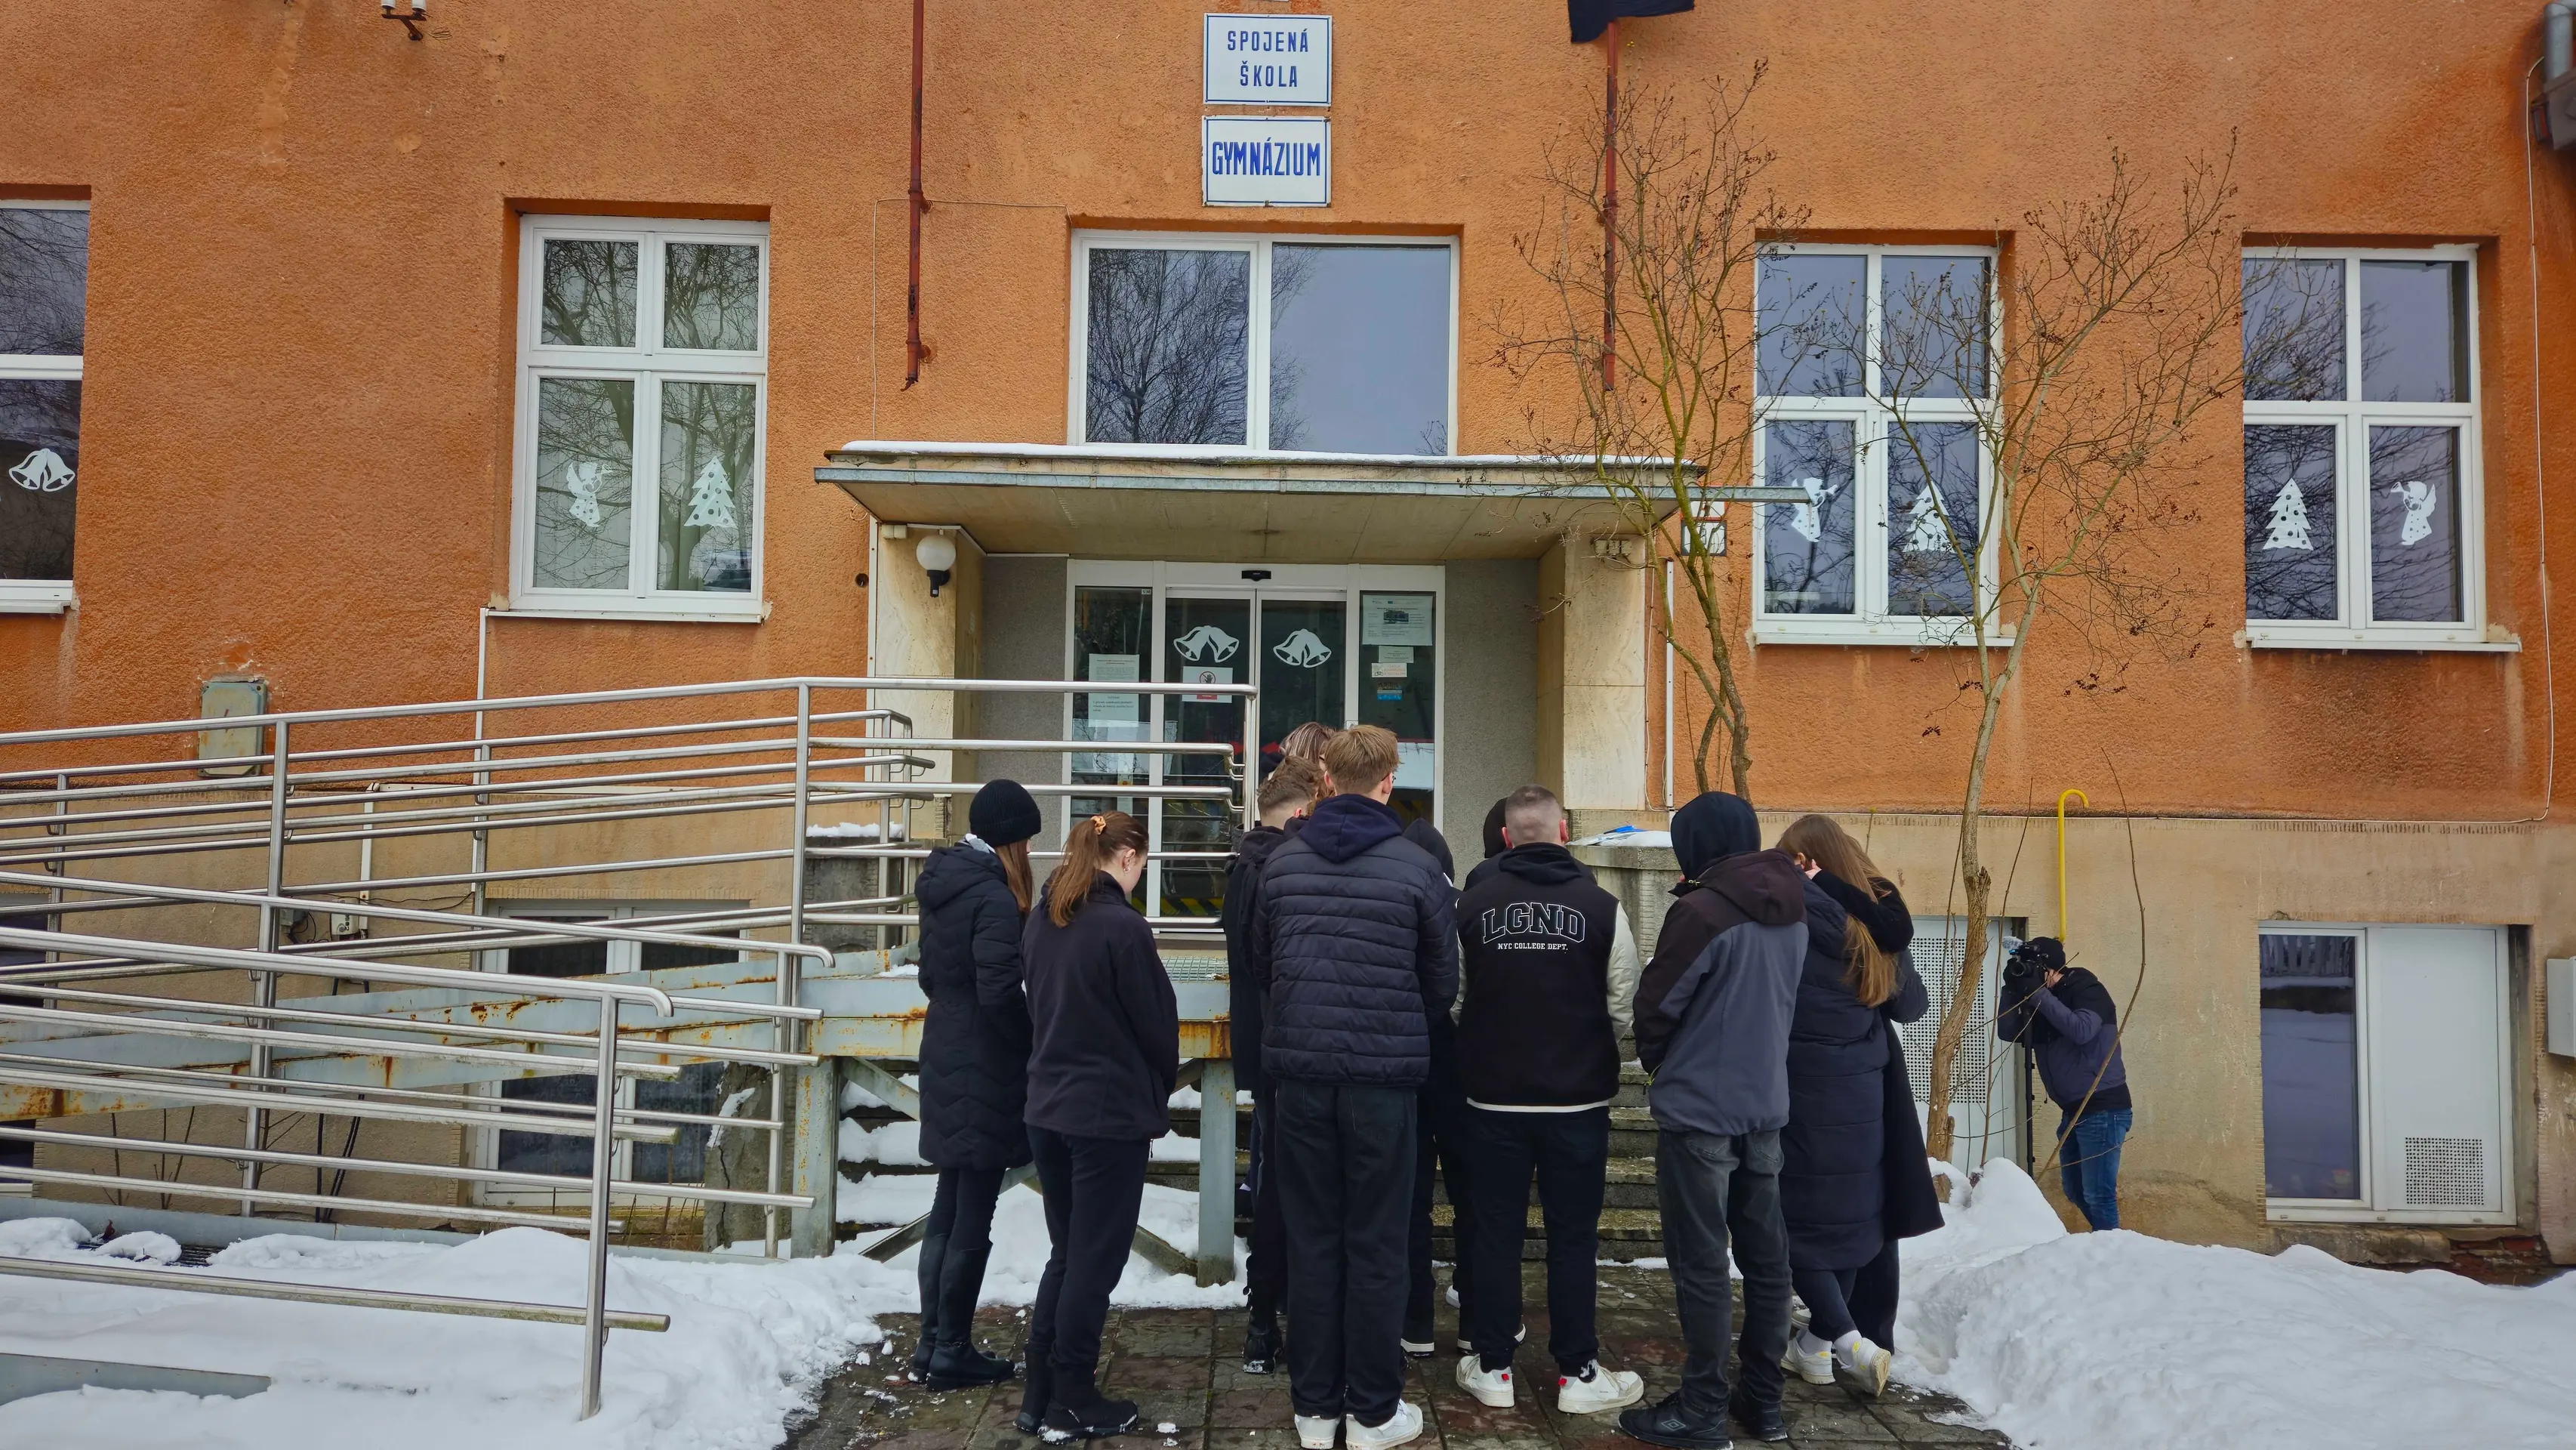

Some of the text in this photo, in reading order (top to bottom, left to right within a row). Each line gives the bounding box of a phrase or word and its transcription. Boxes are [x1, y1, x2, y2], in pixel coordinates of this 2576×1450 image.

[1227, 28, 1309, 53] SPOJENÁ
[1240, 60, 1299, 88] ŠKOLA
[1212, 137, 1321, 177] GYMNÁZIUM
[1482, 902, 1586, 944] LGND
[1547, 943, 1569, 952] DEPT.
